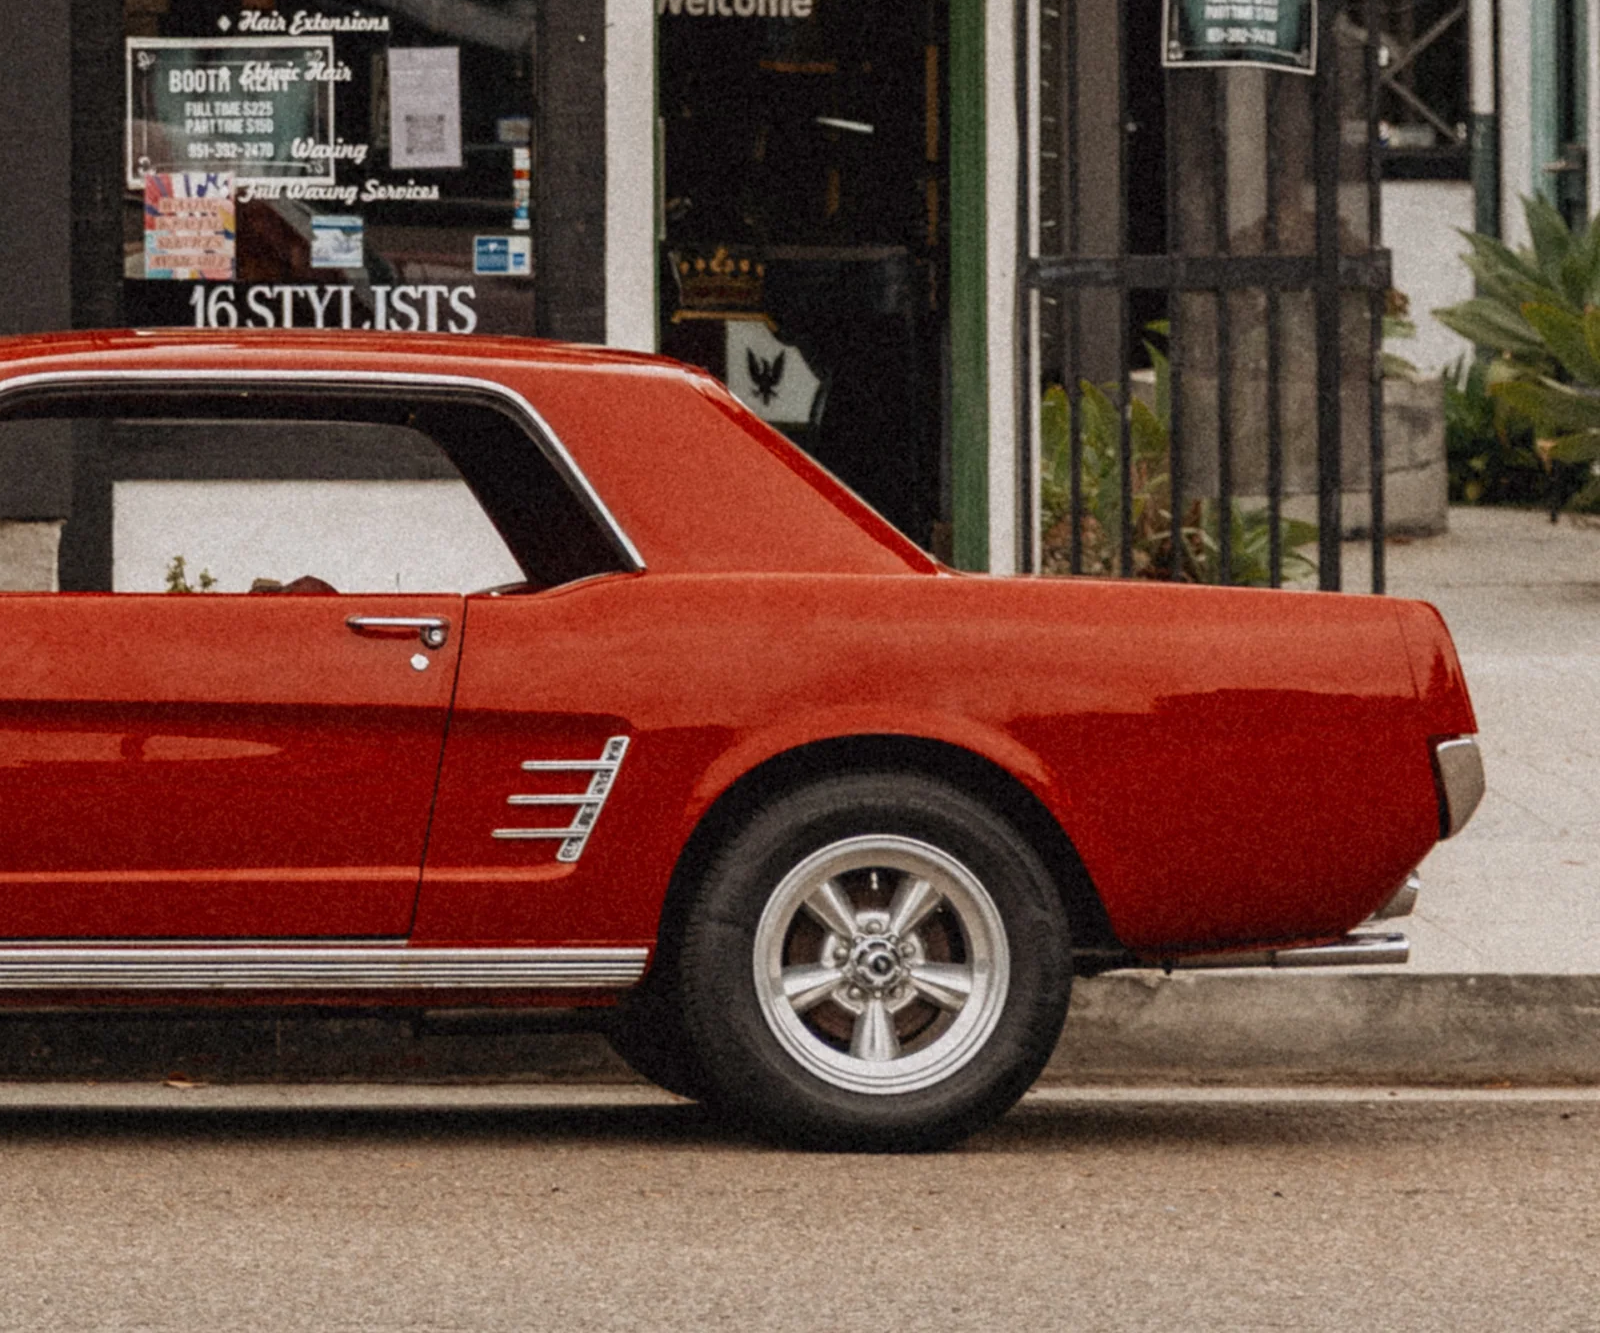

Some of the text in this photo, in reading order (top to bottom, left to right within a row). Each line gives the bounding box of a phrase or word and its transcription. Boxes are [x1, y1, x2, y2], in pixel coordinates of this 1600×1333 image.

[238, 11, 390, 35] Hair Extensions
[169, 70, 232, 93] BOOTH
[304, 61, 352, 81] Hair
[291, 138, 368, 165] Waxing
[238, 180, 440, 204] Full Waxing Services
[189, 286, 478, 334] 16 STYLISTS
